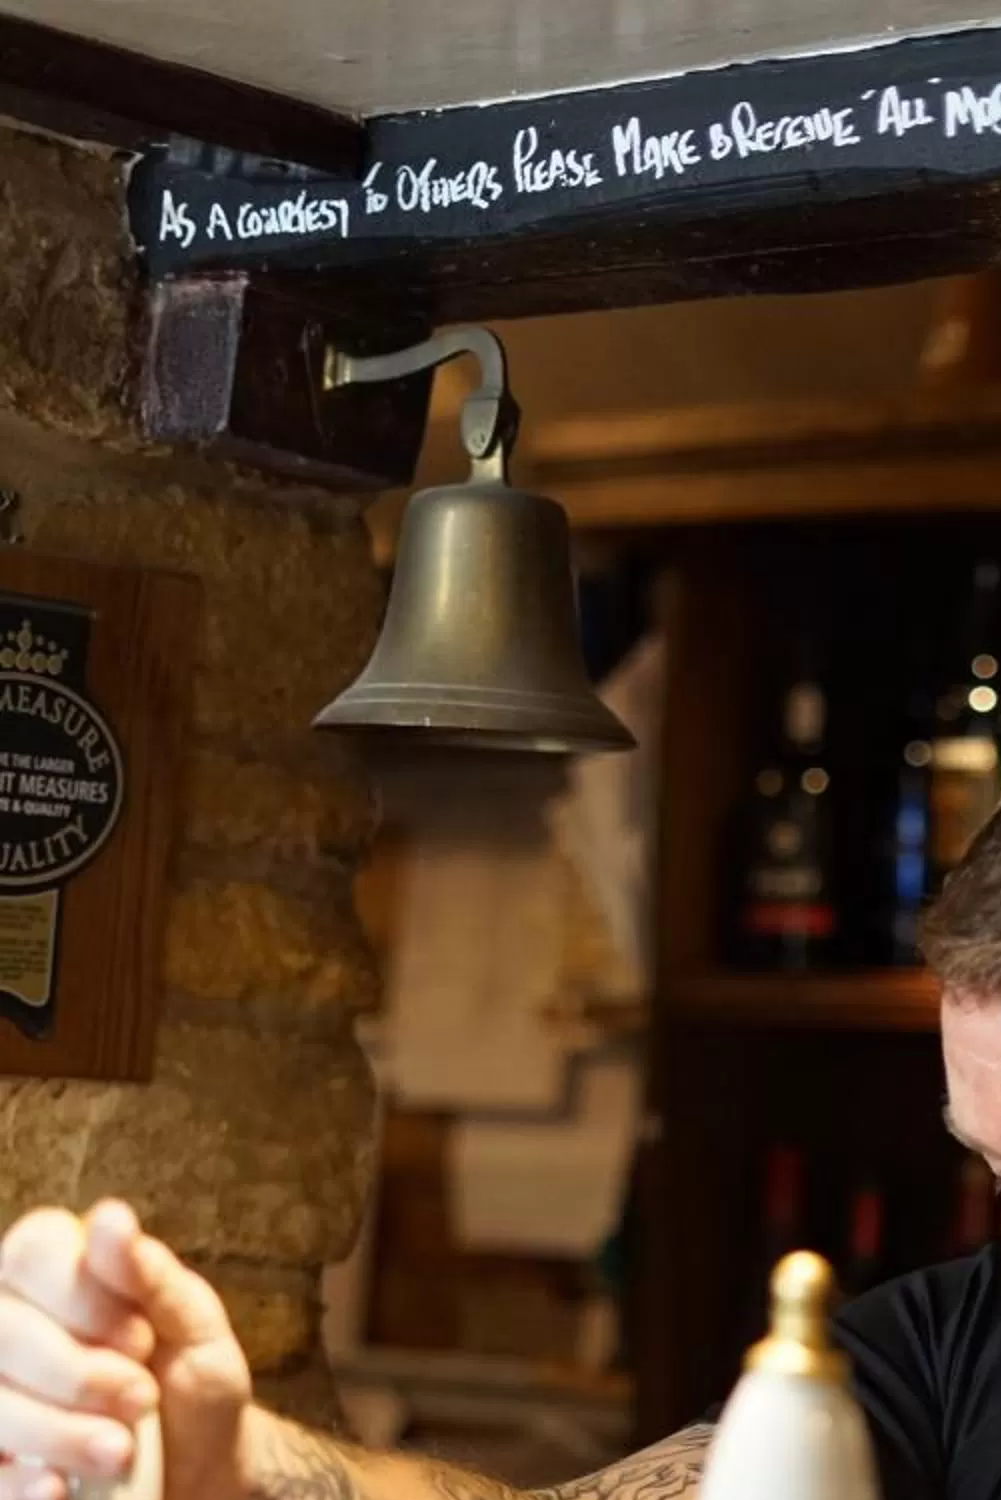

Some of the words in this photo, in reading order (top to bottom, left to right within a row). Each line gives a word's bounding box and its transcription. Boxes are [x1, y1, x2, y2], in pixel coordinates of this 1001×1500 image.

[159, 188, 197, 249] AS
[206, 202, 233, 241] A
[513, 127, 604, 193] PLEASE
[612, 116, 702, 180] MAKE
[18, 773, 109, 804] MEASURES
